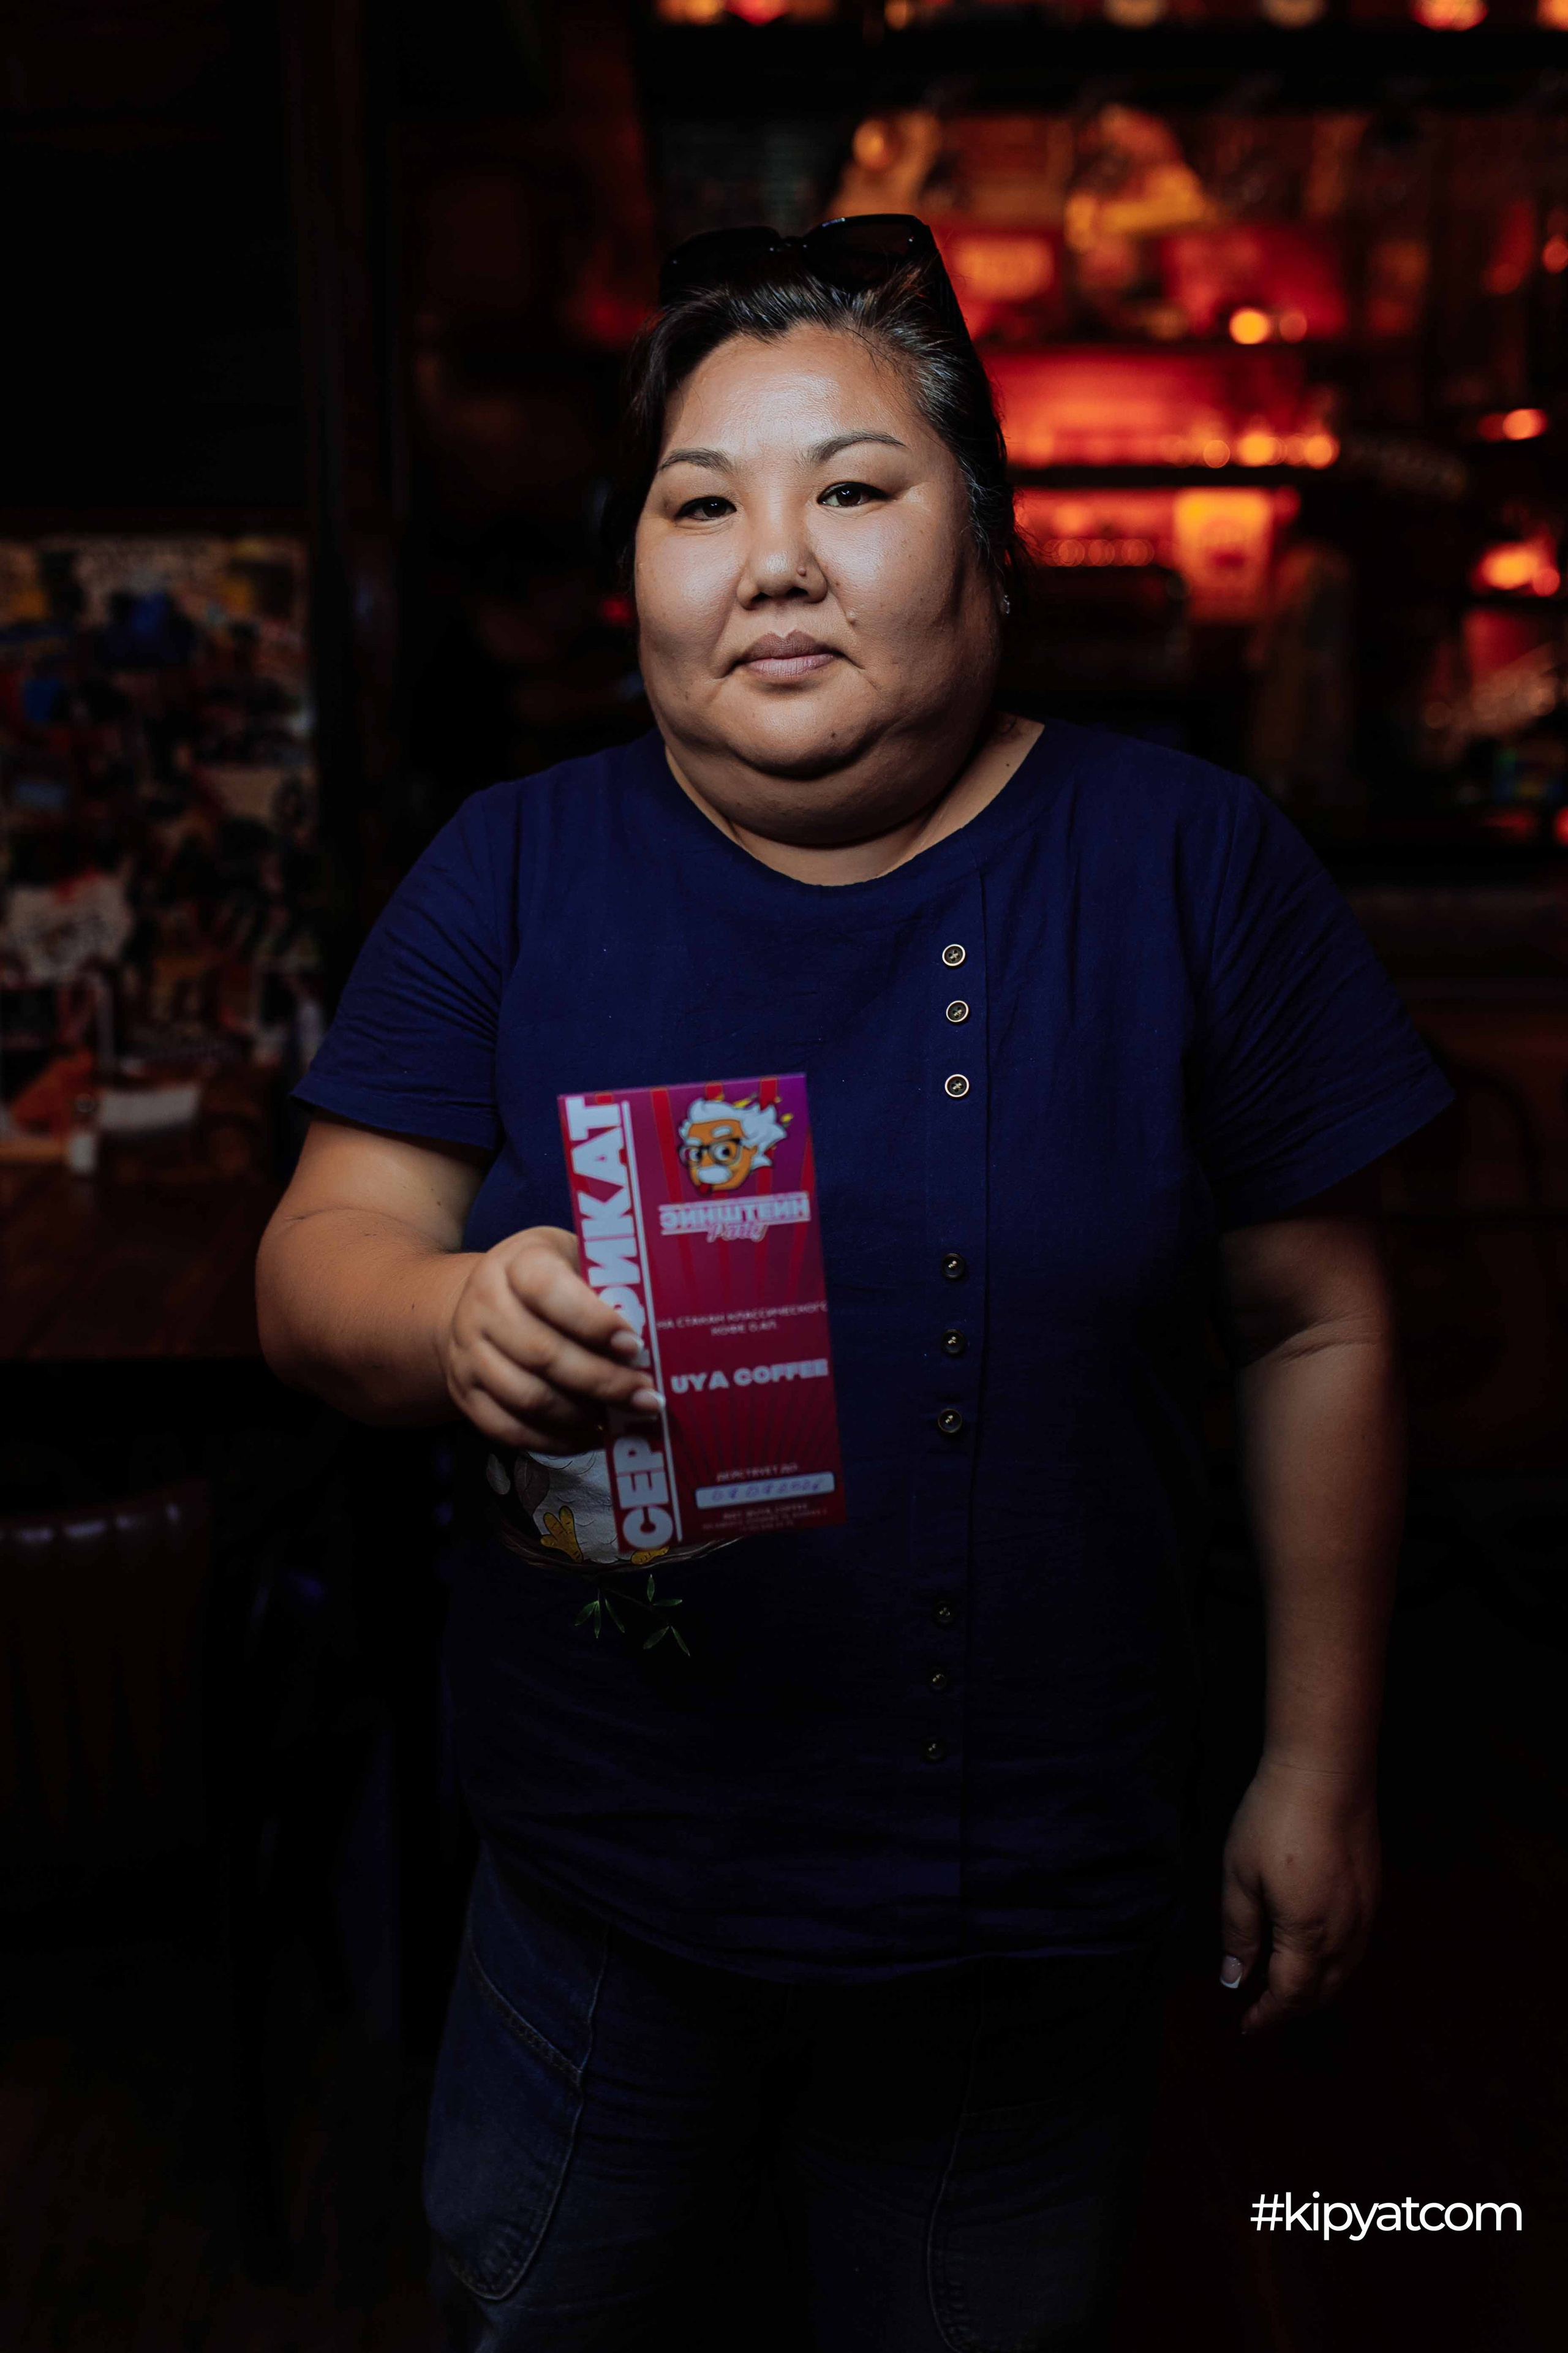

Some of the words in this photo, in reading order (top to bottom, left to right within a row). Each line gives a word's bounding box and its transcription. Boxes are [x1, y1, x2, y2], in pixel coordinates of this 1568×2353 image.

[565, 1097, 674, 1550] СЕРФИКАТ
[656, 1318, 674, 1330] НА
[675, 1312, 725, 1328] СТАКАН
[710, 1322, 745, 1337] КОФЕ
[670, 1370, 730, 1394] UYA
[733, 1358, 829, 1386] COFFEE
